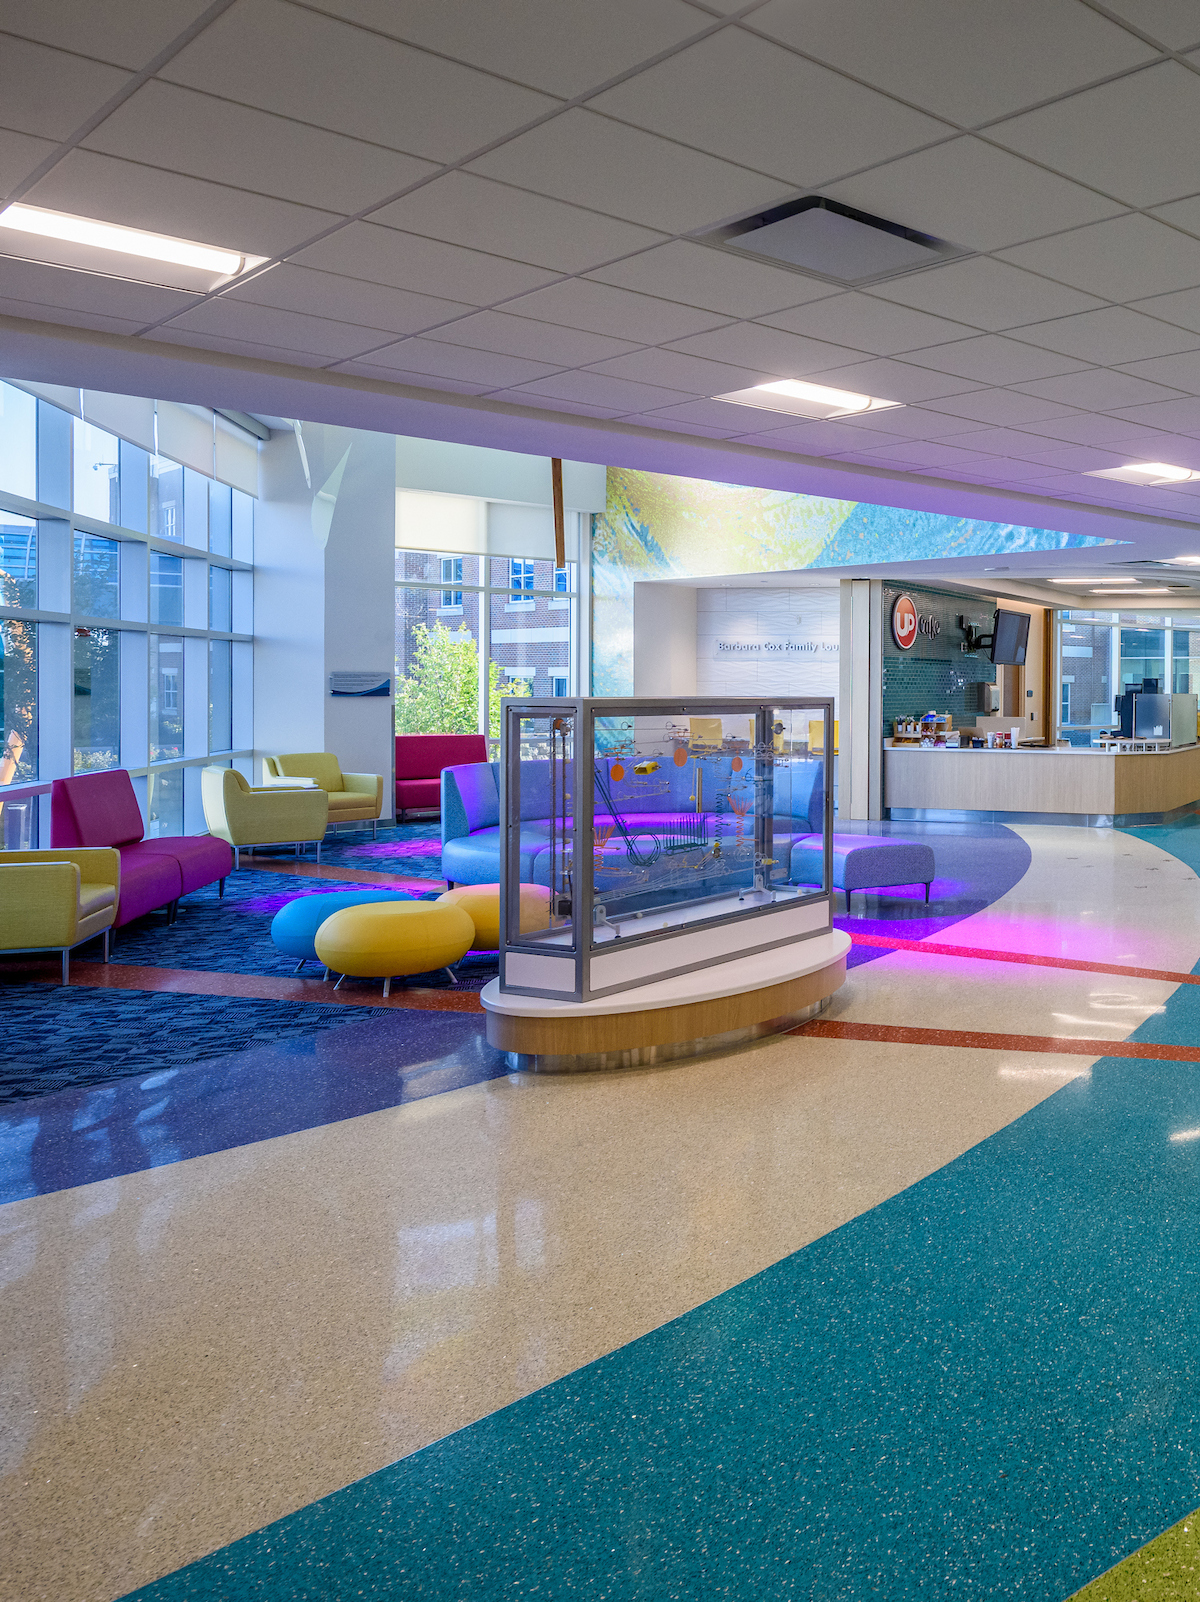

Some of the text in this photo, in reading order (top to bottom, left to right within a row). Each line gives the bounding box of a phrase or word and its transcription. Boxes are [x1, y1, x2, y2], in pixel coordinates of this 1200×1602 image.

[896, 612, 915, 637] UP
[719, 642, 761, 651] Barbara
[764, 641, 782, 651] Cox
[785, 641, 818, 653] Family
